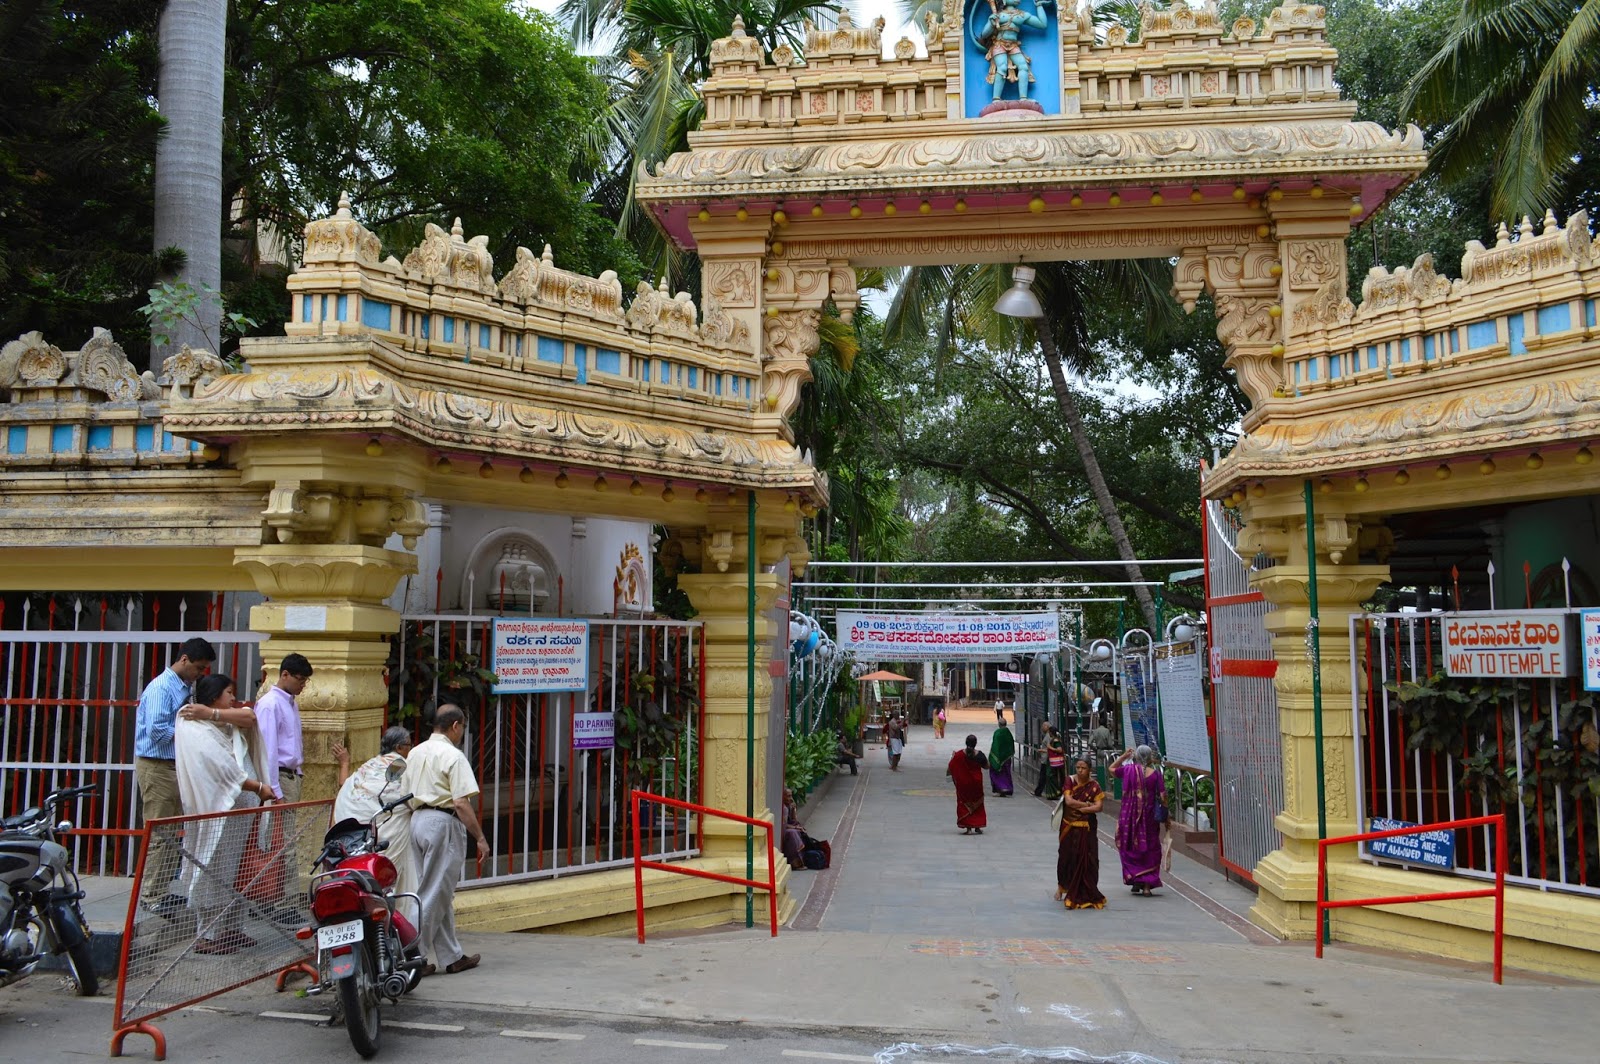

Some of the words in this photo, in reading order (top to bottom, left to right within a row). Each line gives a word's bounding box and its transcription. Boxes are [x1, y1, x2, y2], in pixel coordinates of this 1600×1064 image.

[506, 635, 547, 645] ದರ್ಶನ
[550, 635, 581, 645] ಸಮಯ
[850, 626, 864, 642] ಶ್ರೀ
[983, 631, 1012, 643] ಶಾಂತಿ
[1524, 623, 1560, 644] ದಾರಿ
[1450, 654, 1472, 674] WAY
[1477, 654, 1496, 674] TO
[1498, 653, 1561, 674] TEMPLE
[575, 720, 584, 728] NO
[587, 719, 614, 728] PARKING
[1373, 842, 1387, 852] NOT
[1388, 845, 1421, 860] ALLOWED
[1424, 853, 1447, 865] INSIDE
[1422, 841, 1436, 852] ARE
[327, 932, 356, 945] 5288
